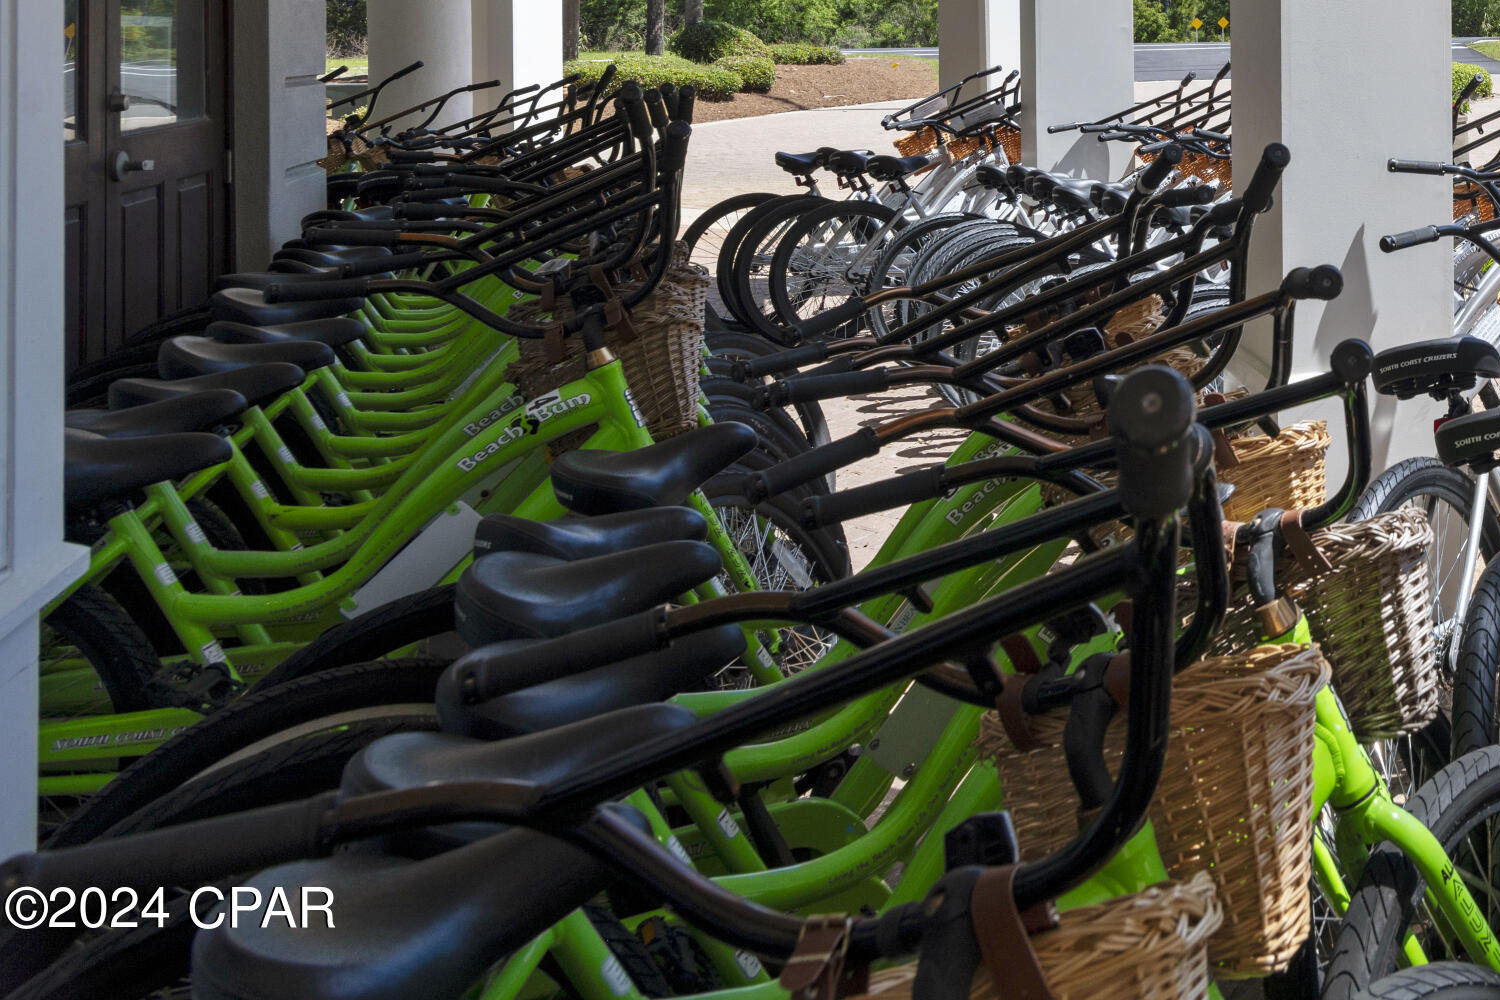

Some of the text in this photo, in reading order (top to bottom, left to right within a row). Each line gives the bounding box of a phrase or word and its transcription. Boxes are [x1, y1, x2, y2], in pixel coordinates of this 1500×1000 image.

[1379, 352, 1458, 374] SOUTH COAST CRUZERS
[463, 394, 525, 437] Beach
[456, 425, 525, 473] Beach
[532, 393, 591, 422] Bum
[1454, 435, 1482, 449] SOUTH
